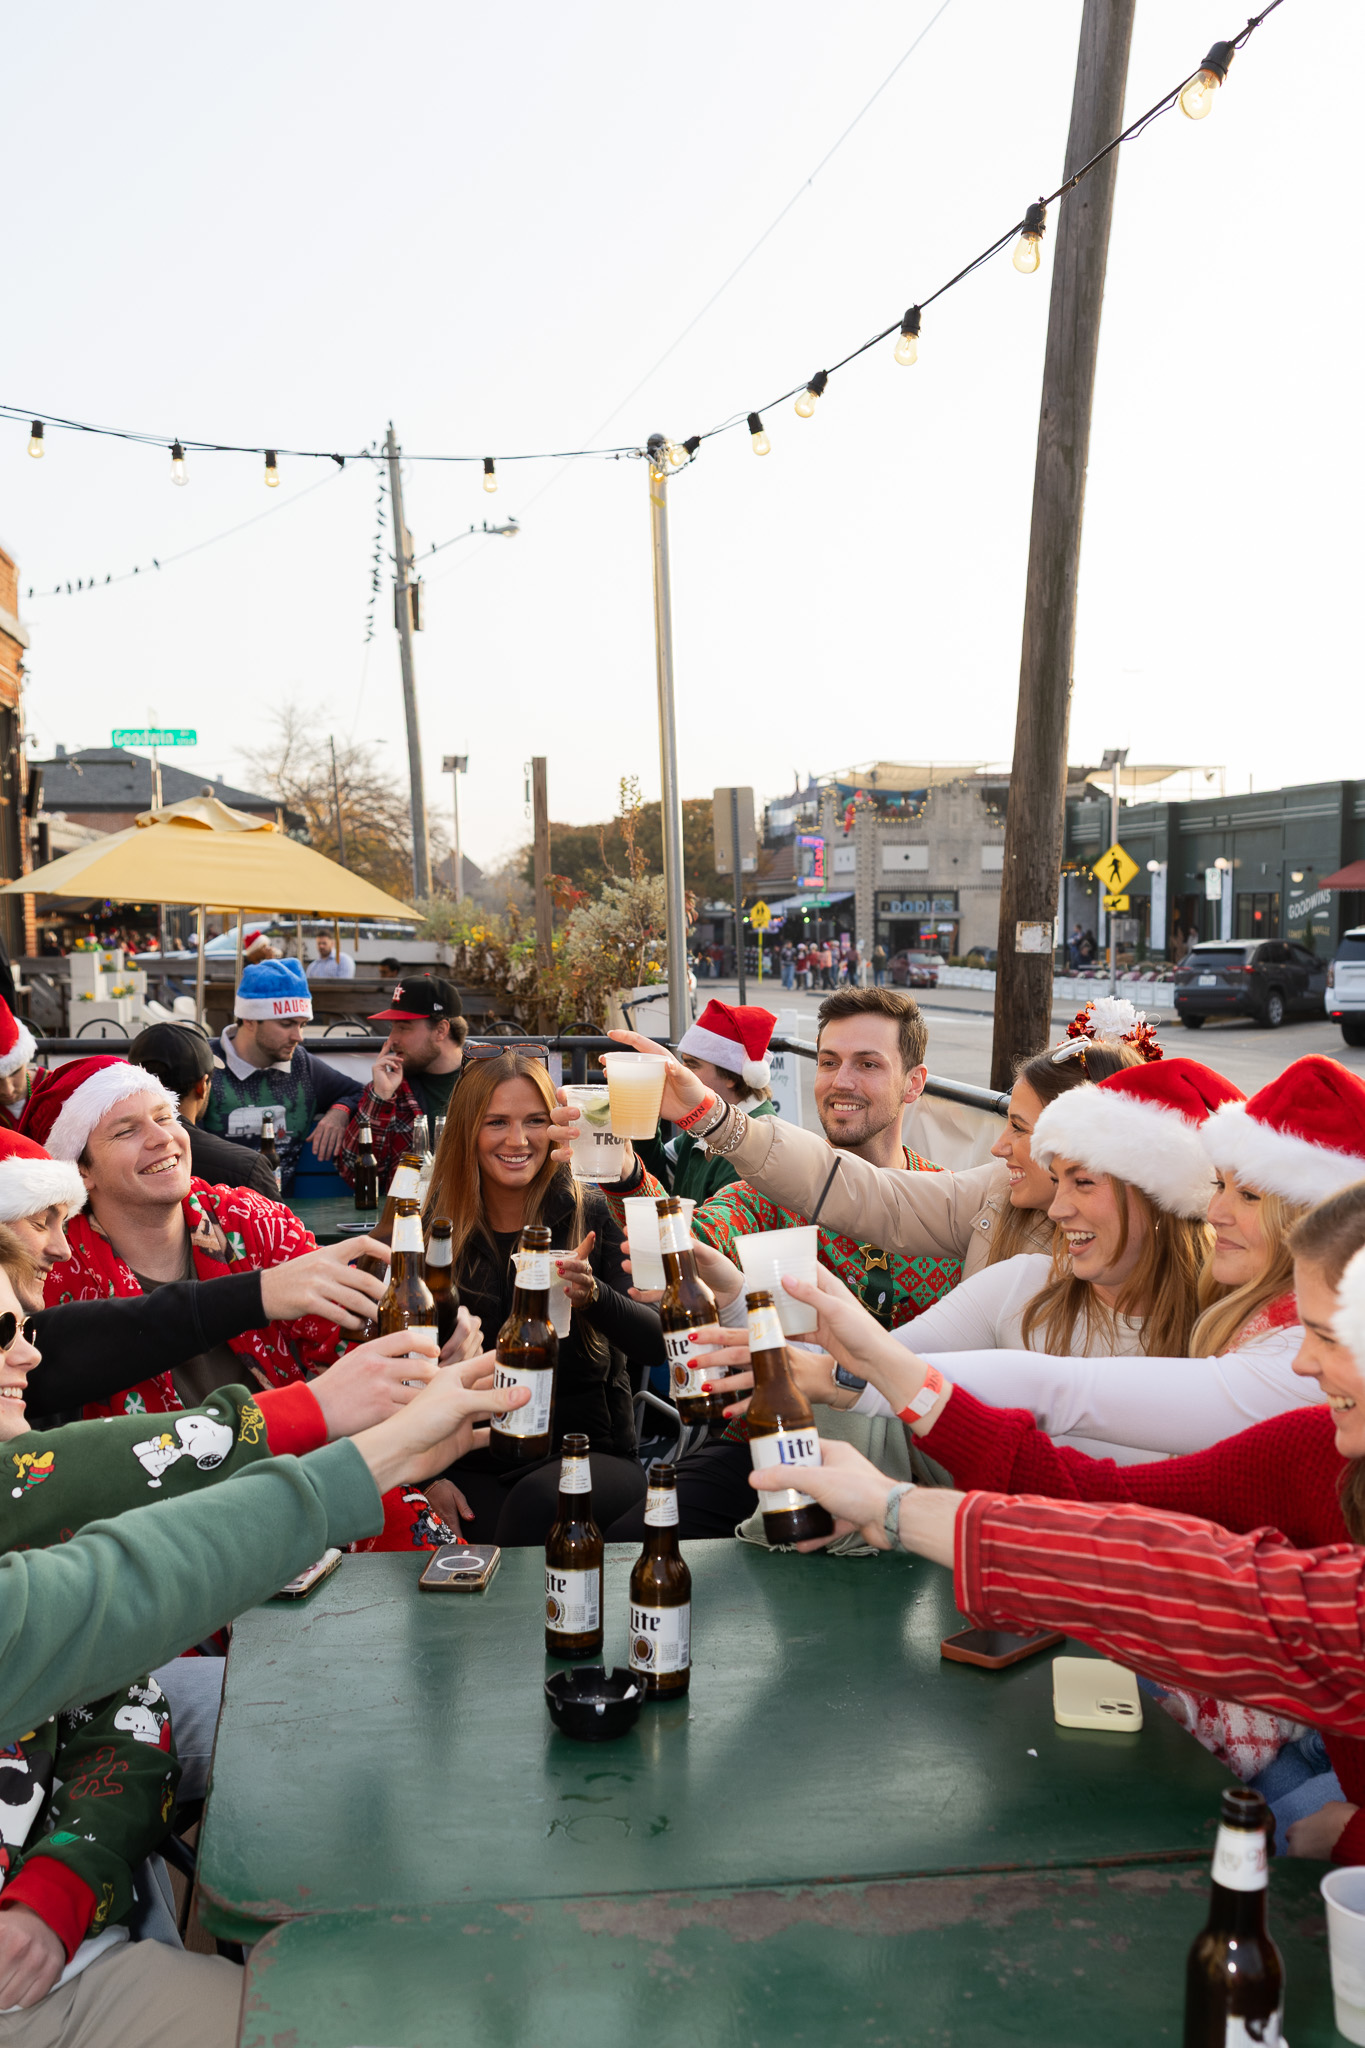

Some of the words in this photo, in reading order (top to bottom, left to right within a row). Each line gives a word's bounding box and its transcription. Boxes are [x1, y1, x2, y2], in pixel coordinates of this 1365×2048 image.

[114, 730, 175, 746] Goodwin
[1288, 888, 1331, 920] GOODWINS
[256, 1208, 275, 1218] BY
[777, 1438, 814, 1465] Lite
[629, 1606, 661, 1634] Lite
